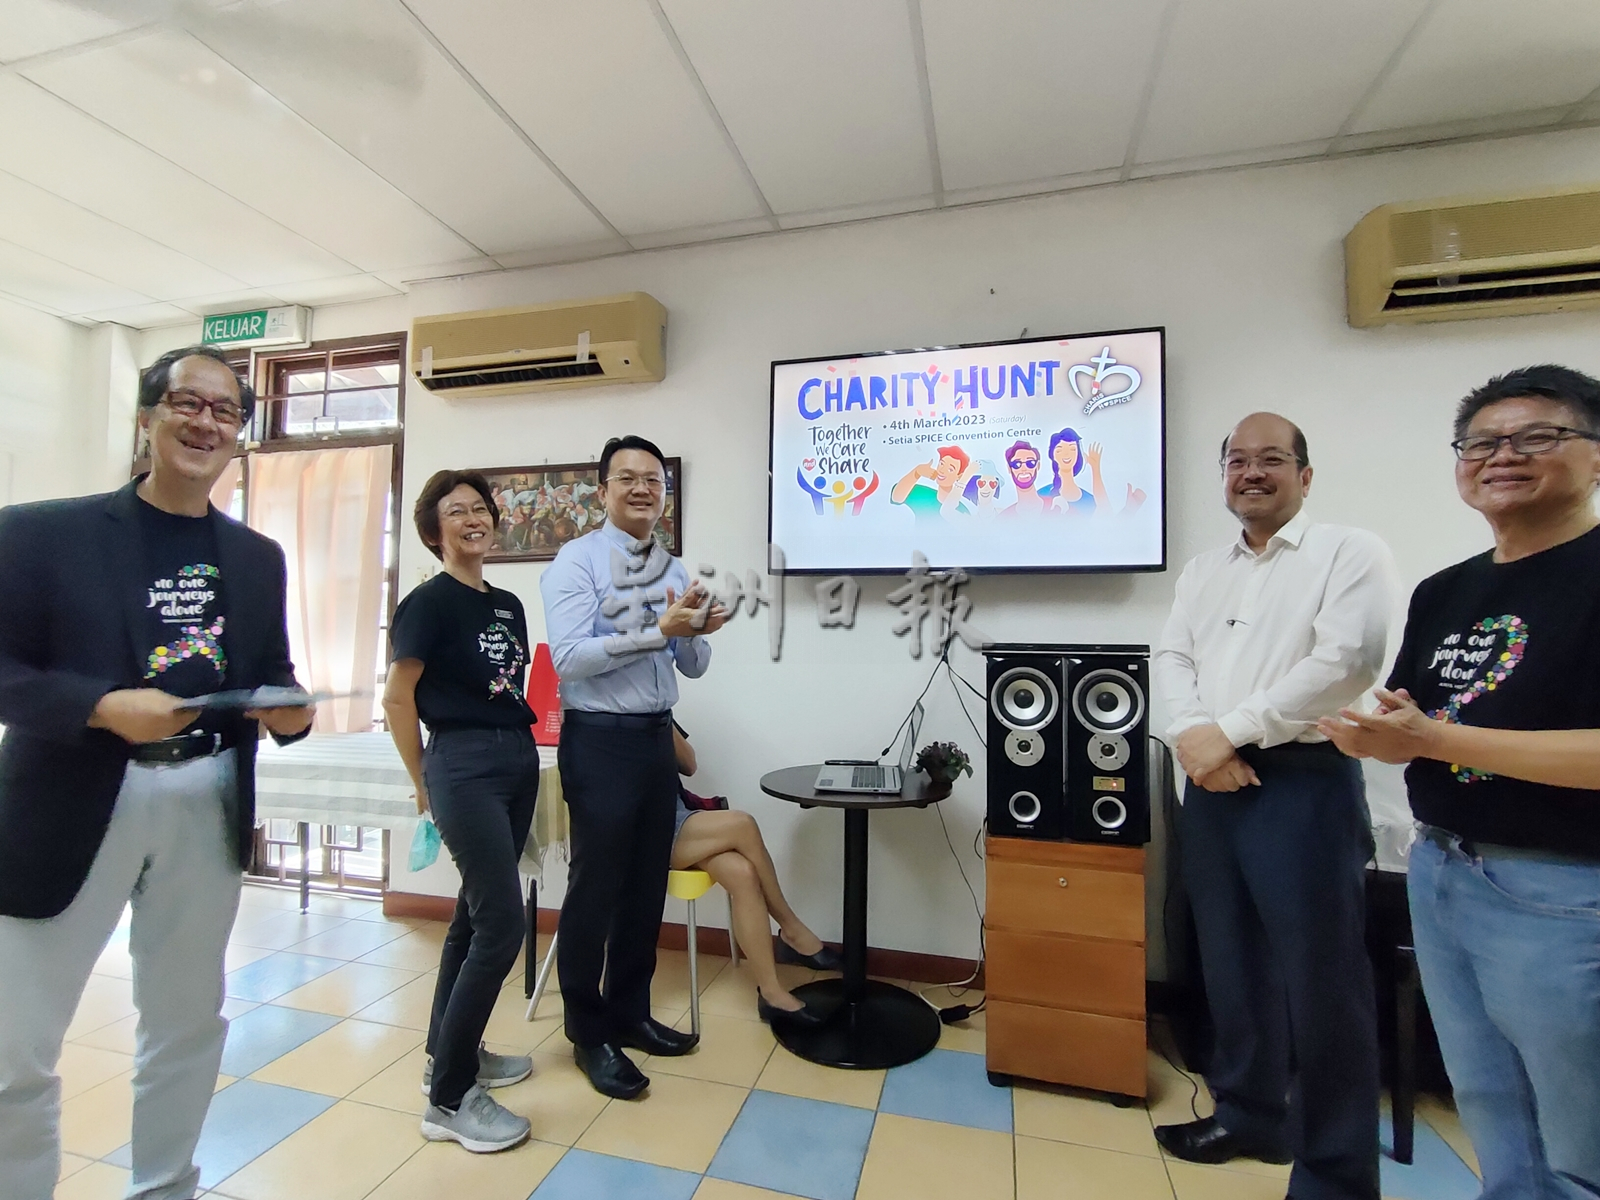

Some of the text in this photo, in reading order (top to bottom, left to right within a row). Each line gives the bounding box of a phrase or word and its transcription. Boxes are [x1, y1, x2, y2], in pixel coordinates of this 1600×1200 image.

[204, 315, 262, 341] KELUAR
[797, 360, 1061, 421] CHARITY HUNT
[1083, 392, 1105, 414] CHARIS
[889, 414, 1027, 430] 4th March 2023 (Saturday)
[807, 422, 872, 446] Together
[888, 427, 1042, 446] Setia SPICE Convention Centre
[815, 442, 866, 460] We Care
[154, 578, 208, 589] no one
[145, 587, 215, 608] journeys
[160, 600, 205, 616] alone
[1443, 633, 1461, 645] no
